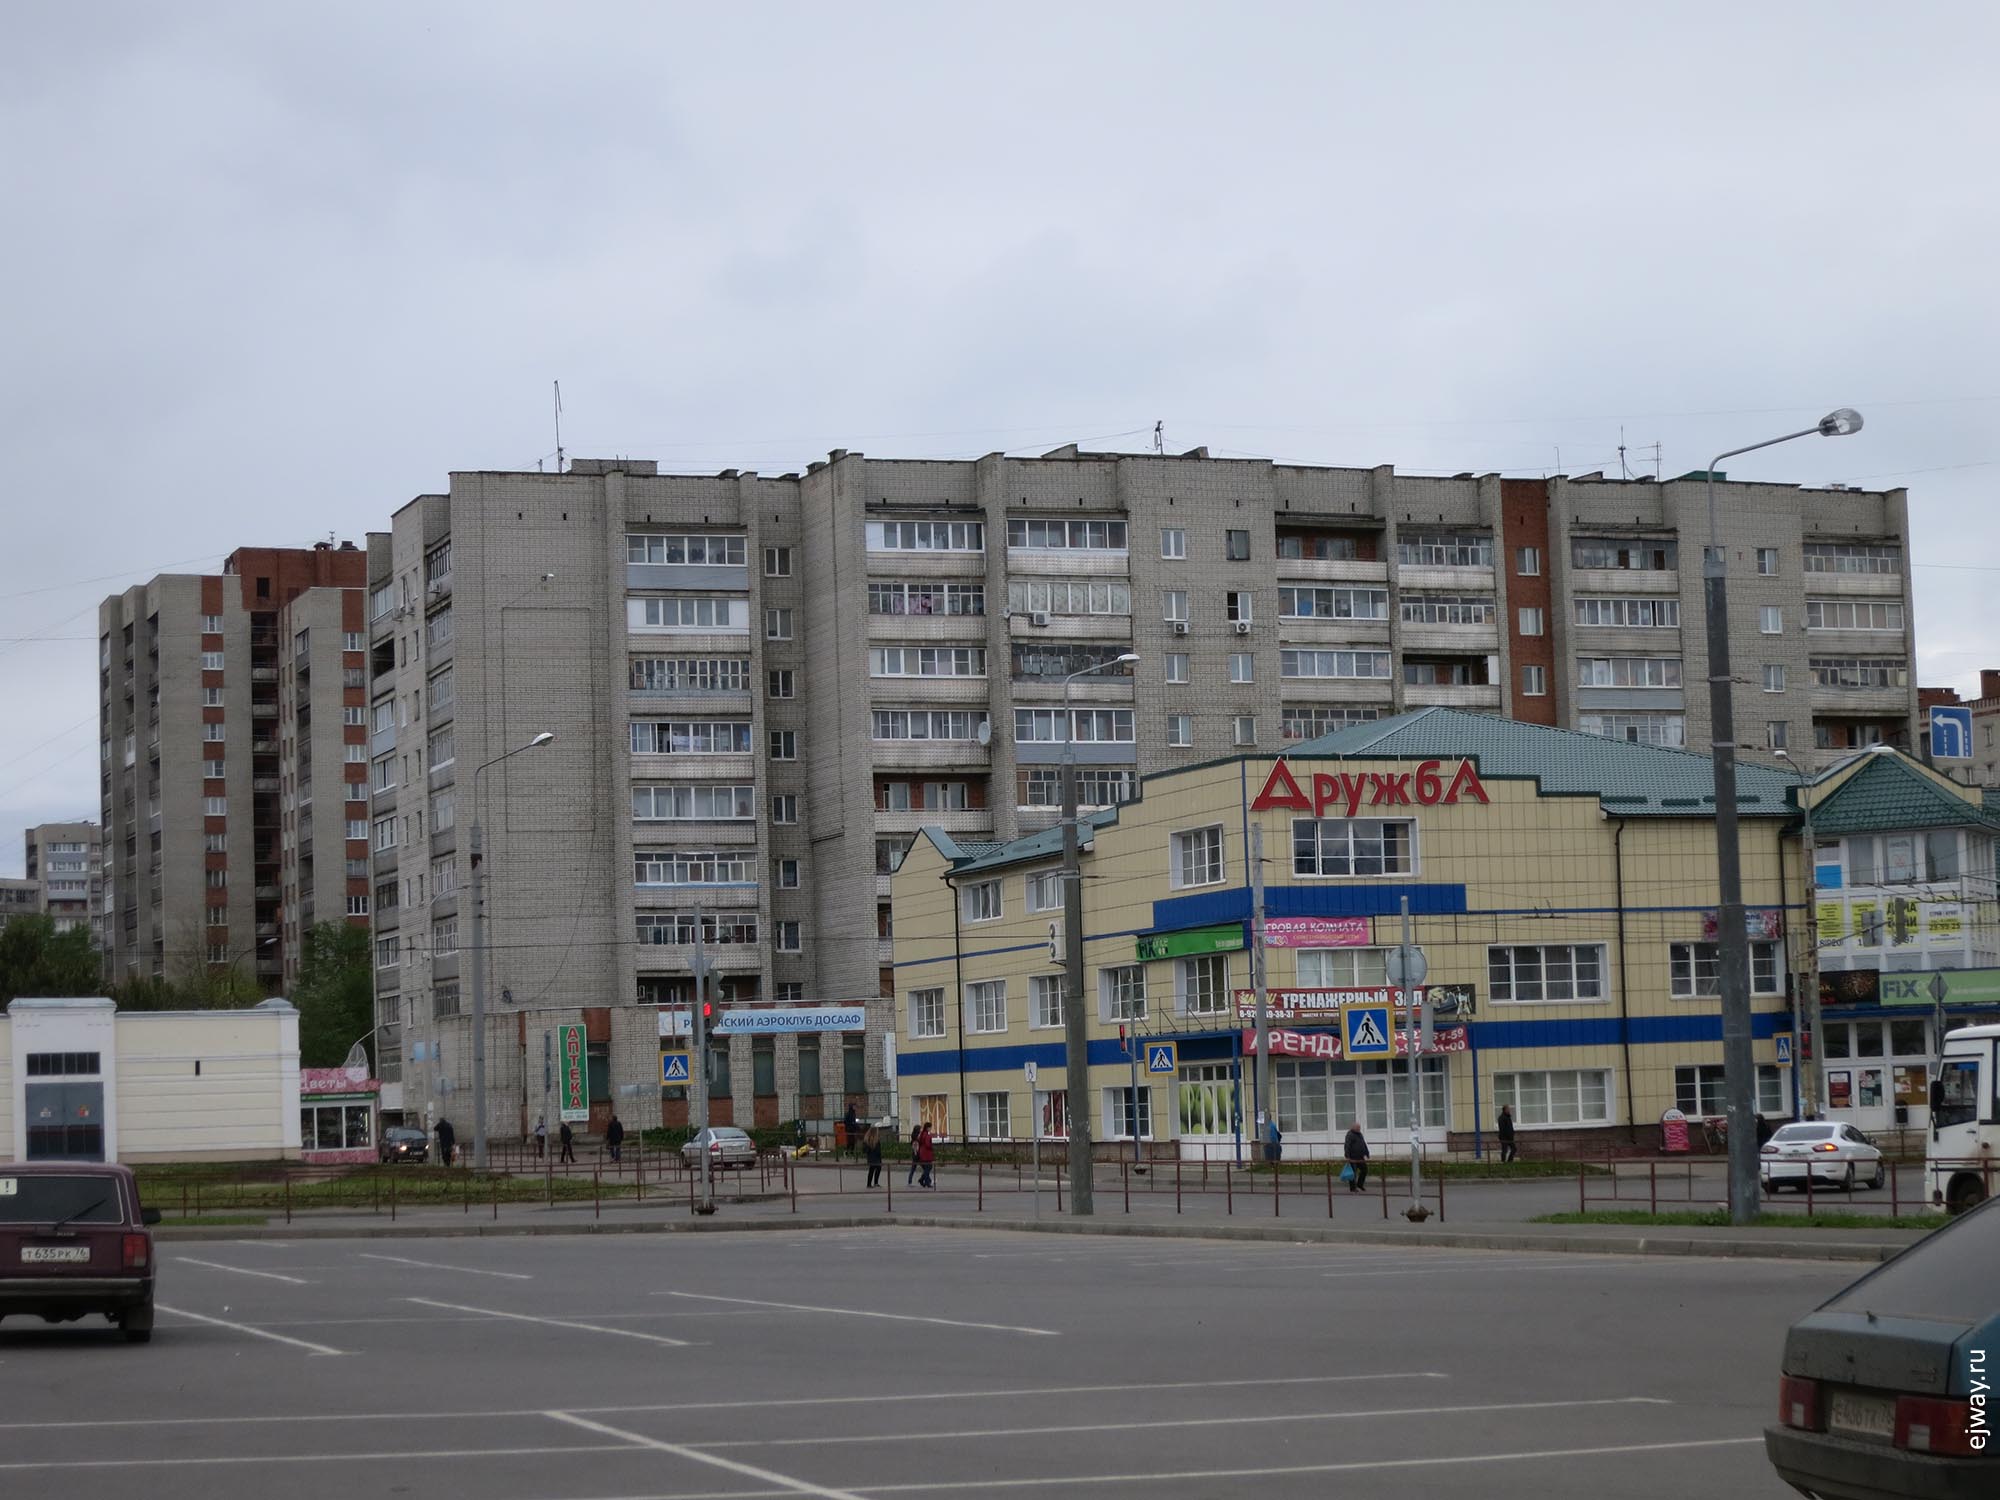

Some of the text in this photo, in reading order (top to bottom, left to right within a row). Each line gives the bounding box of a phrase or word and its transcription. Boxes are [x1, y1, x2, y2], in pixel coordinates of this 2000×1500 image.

[1281, 988, 1388, 1009] ТРЕНАЖЕРНЫЙ
[756, 1016, 813, 1026] АЭРОКЛУБ
[815, 1014, 861, 1026] ДОСААФ
[566, 1026, 582, 1109] АПТЕКА
